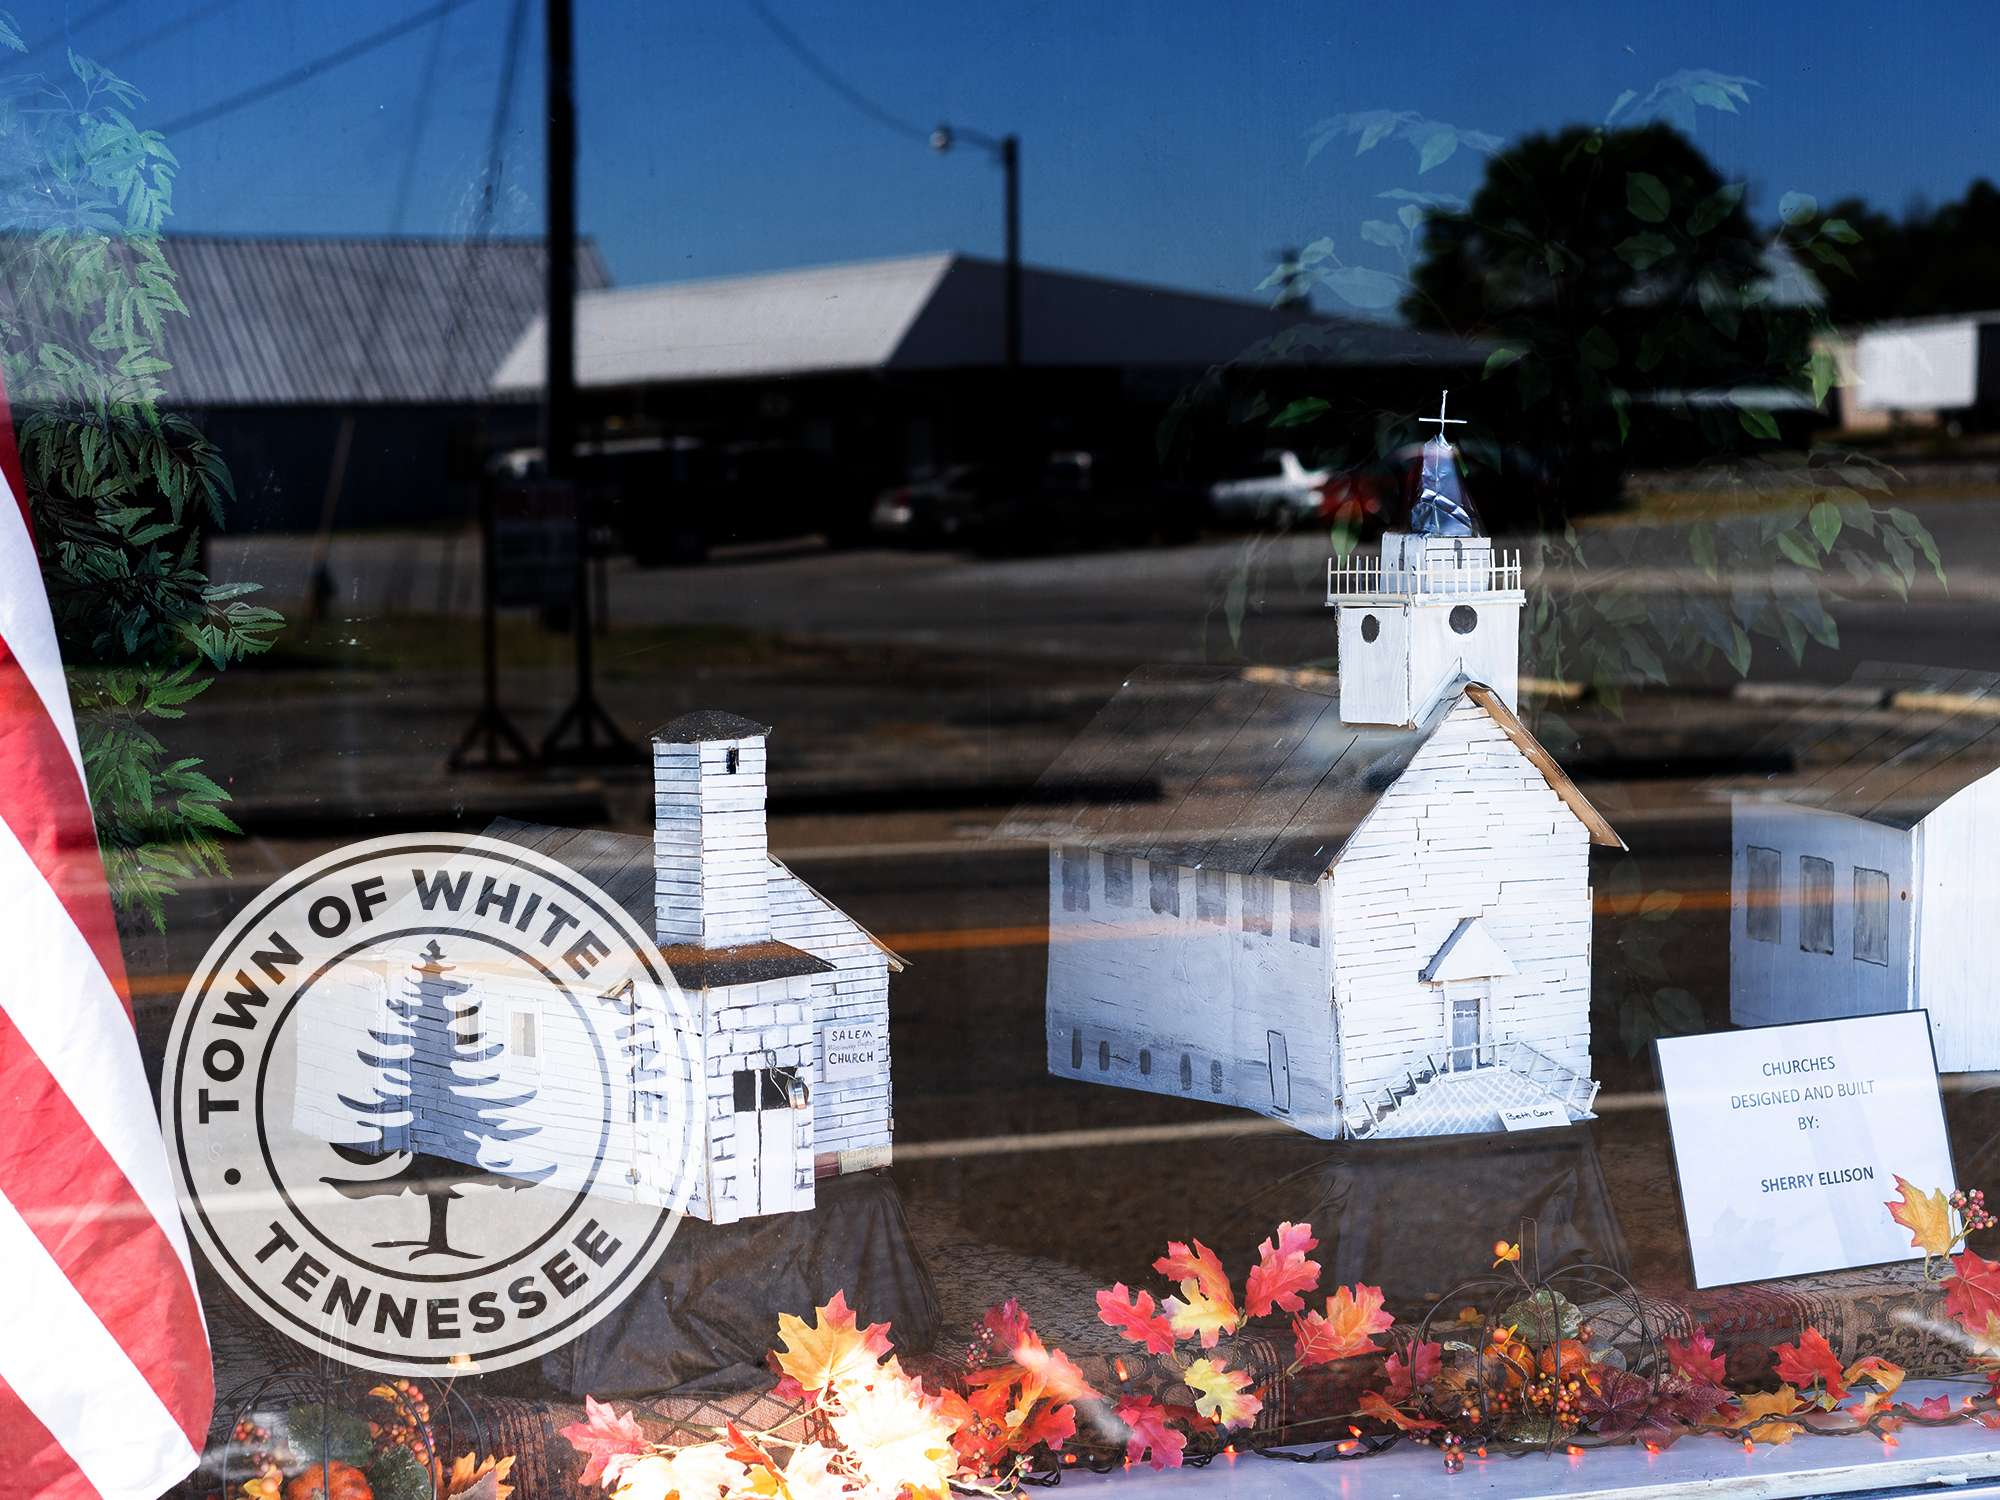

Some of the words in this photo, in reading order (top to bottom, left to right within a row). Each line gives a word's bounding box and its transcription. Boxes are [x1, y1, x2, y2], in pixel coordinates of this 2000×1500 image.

[199, 931, 304, 1124] TOWN
[308, 874, 389, 938] OF
[412, 868, 611, 982] WHITE
[597, 981, 669, 1123] PINE
[831, 1029, 873, 1042] SALEM
[828, 1050, 874, 1065] CHURCH
[1762, 1055, 1836, 1077] CHURCHES
[1730, 1087, 1800, 1110] DESIGNED
[1804, 1084, 1834, 1102] AND
[1838, 1080, 1875, 1097] BUILT
[1797, 1115, 1820, 1131] BY:
[1760, 1173, 1815, 1193] SHERRY
[1818, 1166, 1875, 1186] ELLISON
[254, 1217, 623, 1340] TENNESSEE
